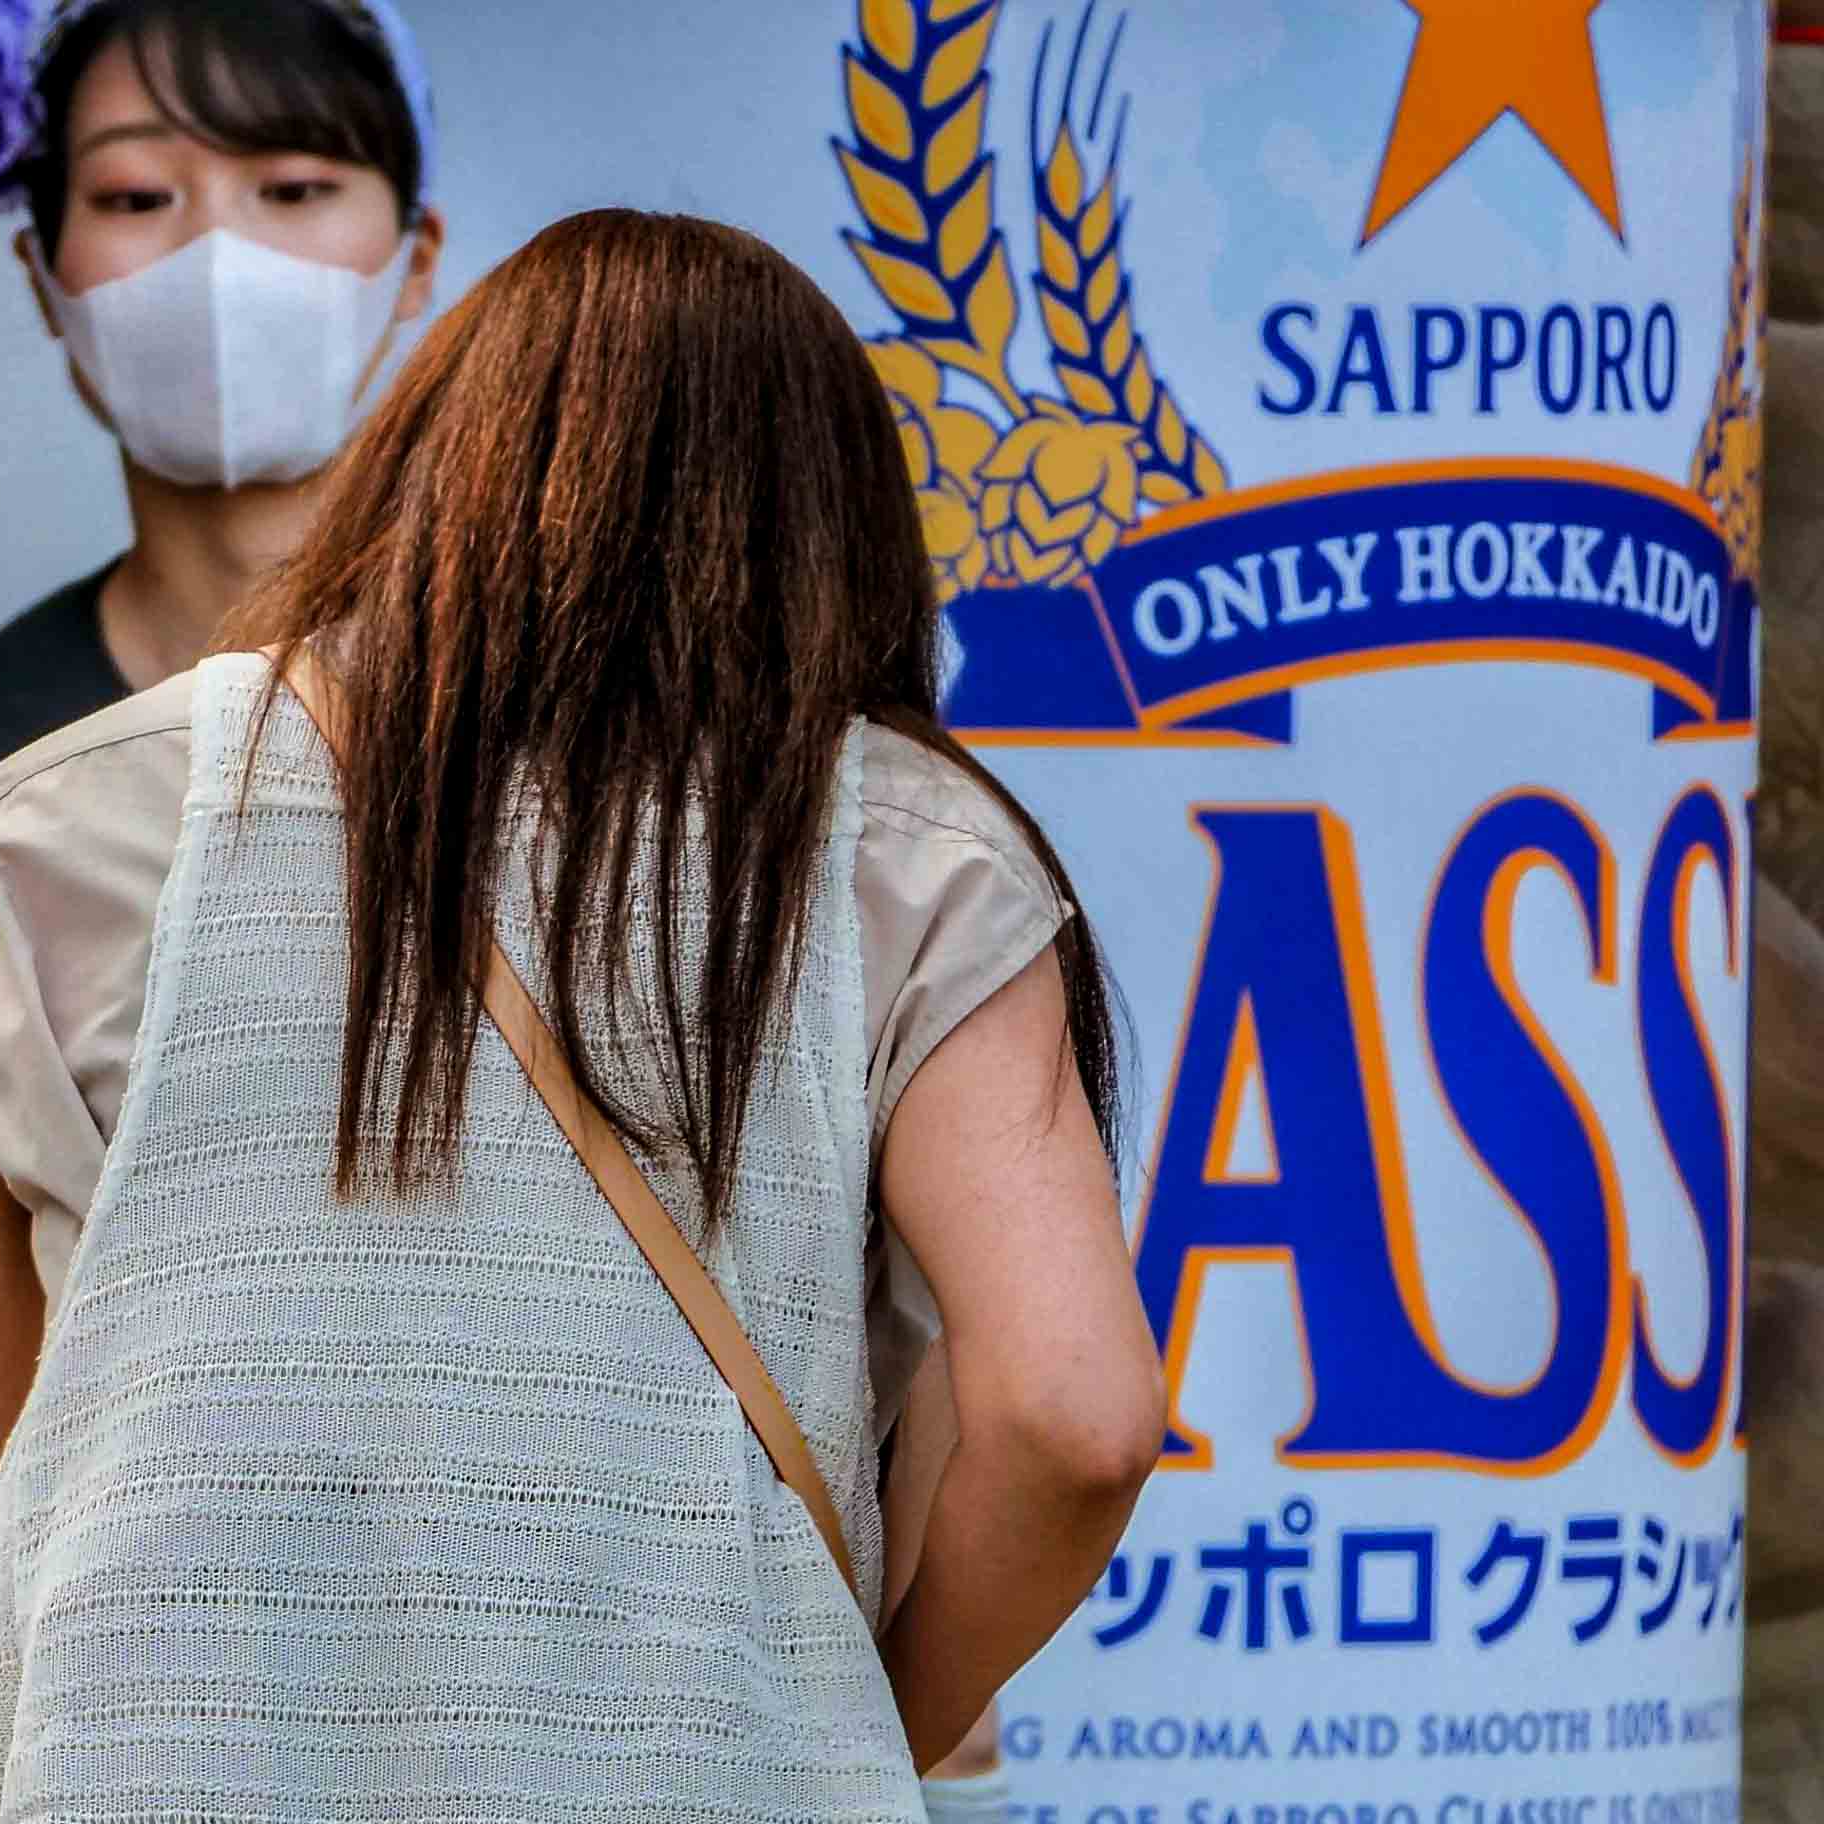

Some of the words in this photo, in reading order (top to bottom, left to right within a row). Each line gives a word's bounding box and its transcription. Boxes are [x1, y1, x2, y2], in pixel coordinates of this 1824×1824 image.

[1259, 302, 1678, 416] SAPPORO
[1133, 532, 1368, 657] ONLY
[1397, 521, 1720, 646] HOKKAIDO
[1068, 1713, 1270, 1762] AROMA
[1291, 1712, 1402, 1760] AND
[1418, 1710, 1590, 1757] SMOOTH
